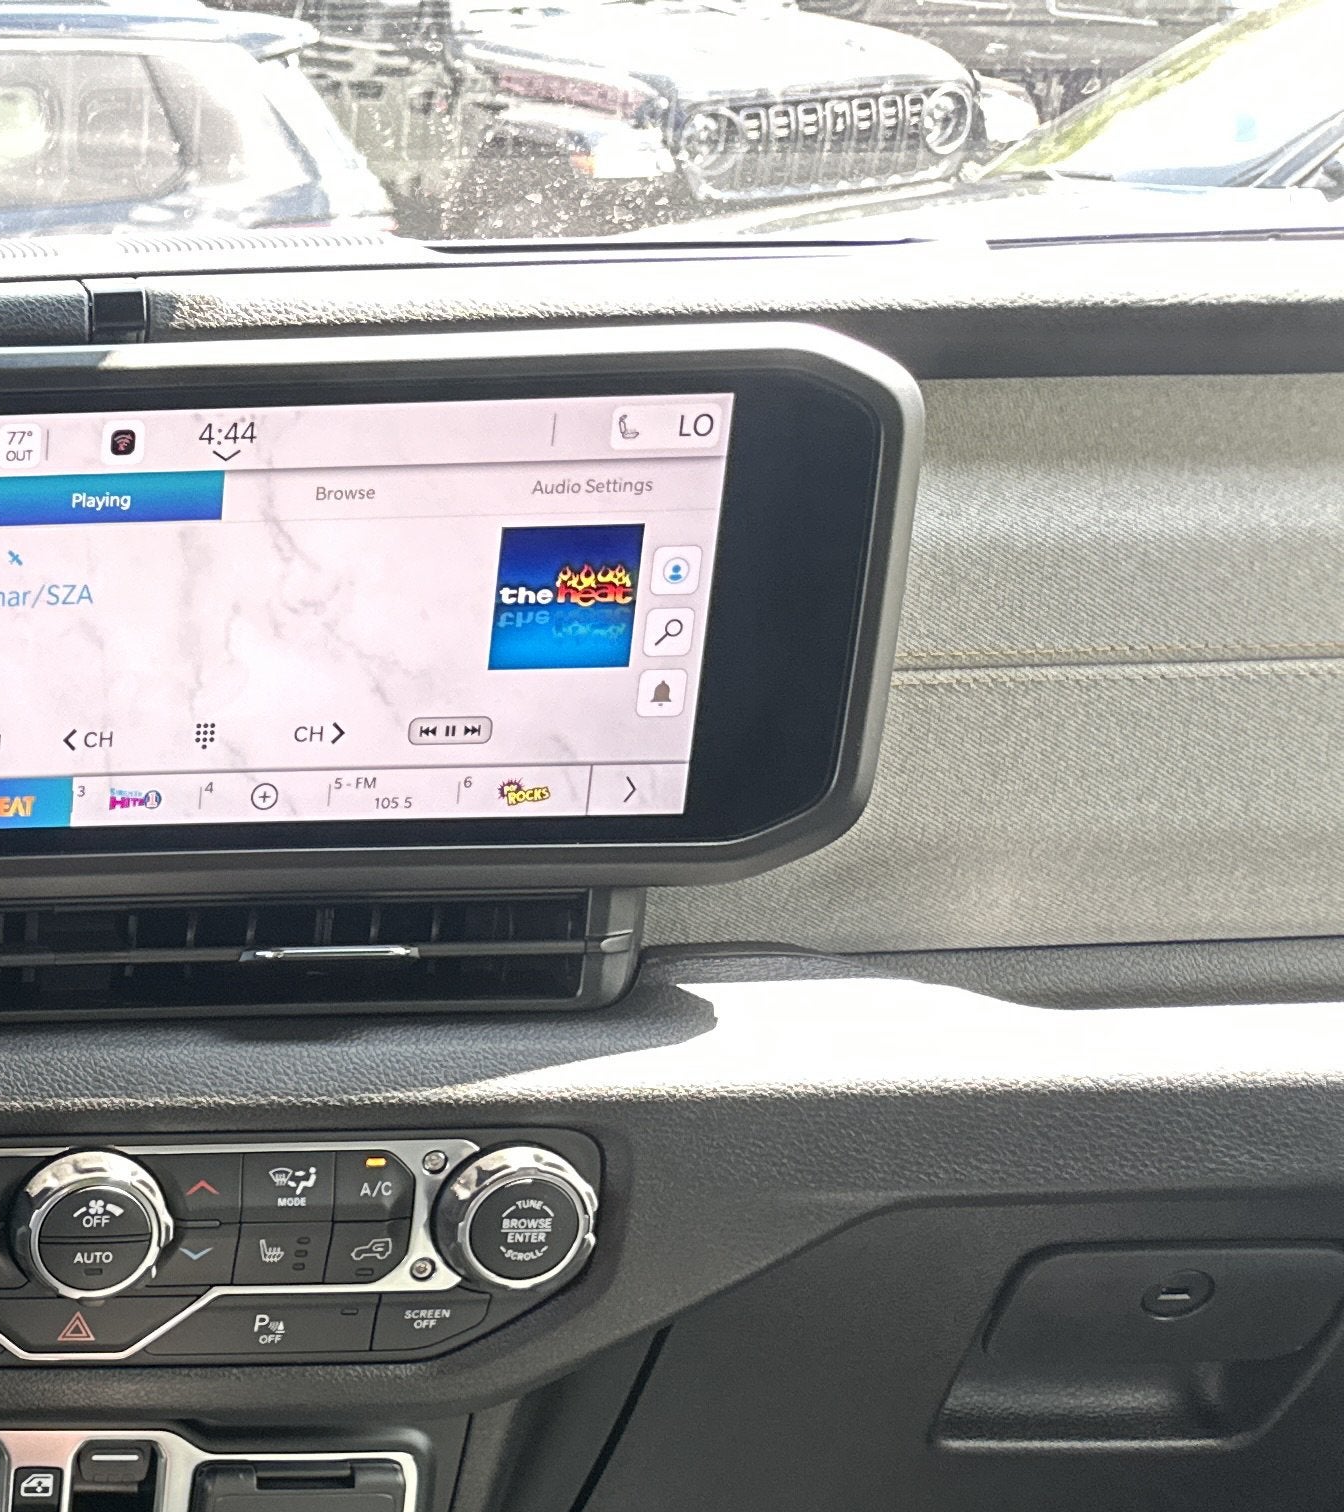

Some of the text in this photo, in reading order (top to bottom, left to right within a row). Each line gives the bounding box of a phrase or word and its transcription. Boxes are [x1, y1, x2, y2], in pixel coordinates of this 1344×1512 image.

[678, 413, 714, 438] LO
[198, 421, 258, 446] 4:44
[6, 450, 33, 462] OUT
[315, 485, 376, 502] Browse
[532, 477, 654, 498] Audio Settings
[71, 492, 132, 511] Playing
[499, 583, 633, 607] the heat
[83, 731, 114, 749] CH
[294, 725, 324, 743] CH
[205, 782, 214, 793] 4
[334, 777, 376, 789] 5 FM
[464, 776, 473, 788] 6
[78, 786, 86, 797] 3
[507, 786, 550, 806] ROCKS
[360, 1181, 392, 1198] A/C
[277, 1197, 306, 1207] MODE
[515, 1199, 544, 1210] TUNE
[82, 1215, 110, 1228] OFF
[502, 1218, 552, 1229] BROWSE
[507, 1232, 546, 1243] ENTER
[73, 1251, 113, 1264] AUTO
[504, 1249, 544, 1261] SCROLL
[404, 1309, 451, 1320] SCREEN
[413, 1318, 437, 1328] OFF
[259, 1334, 282, 1344] OFF
